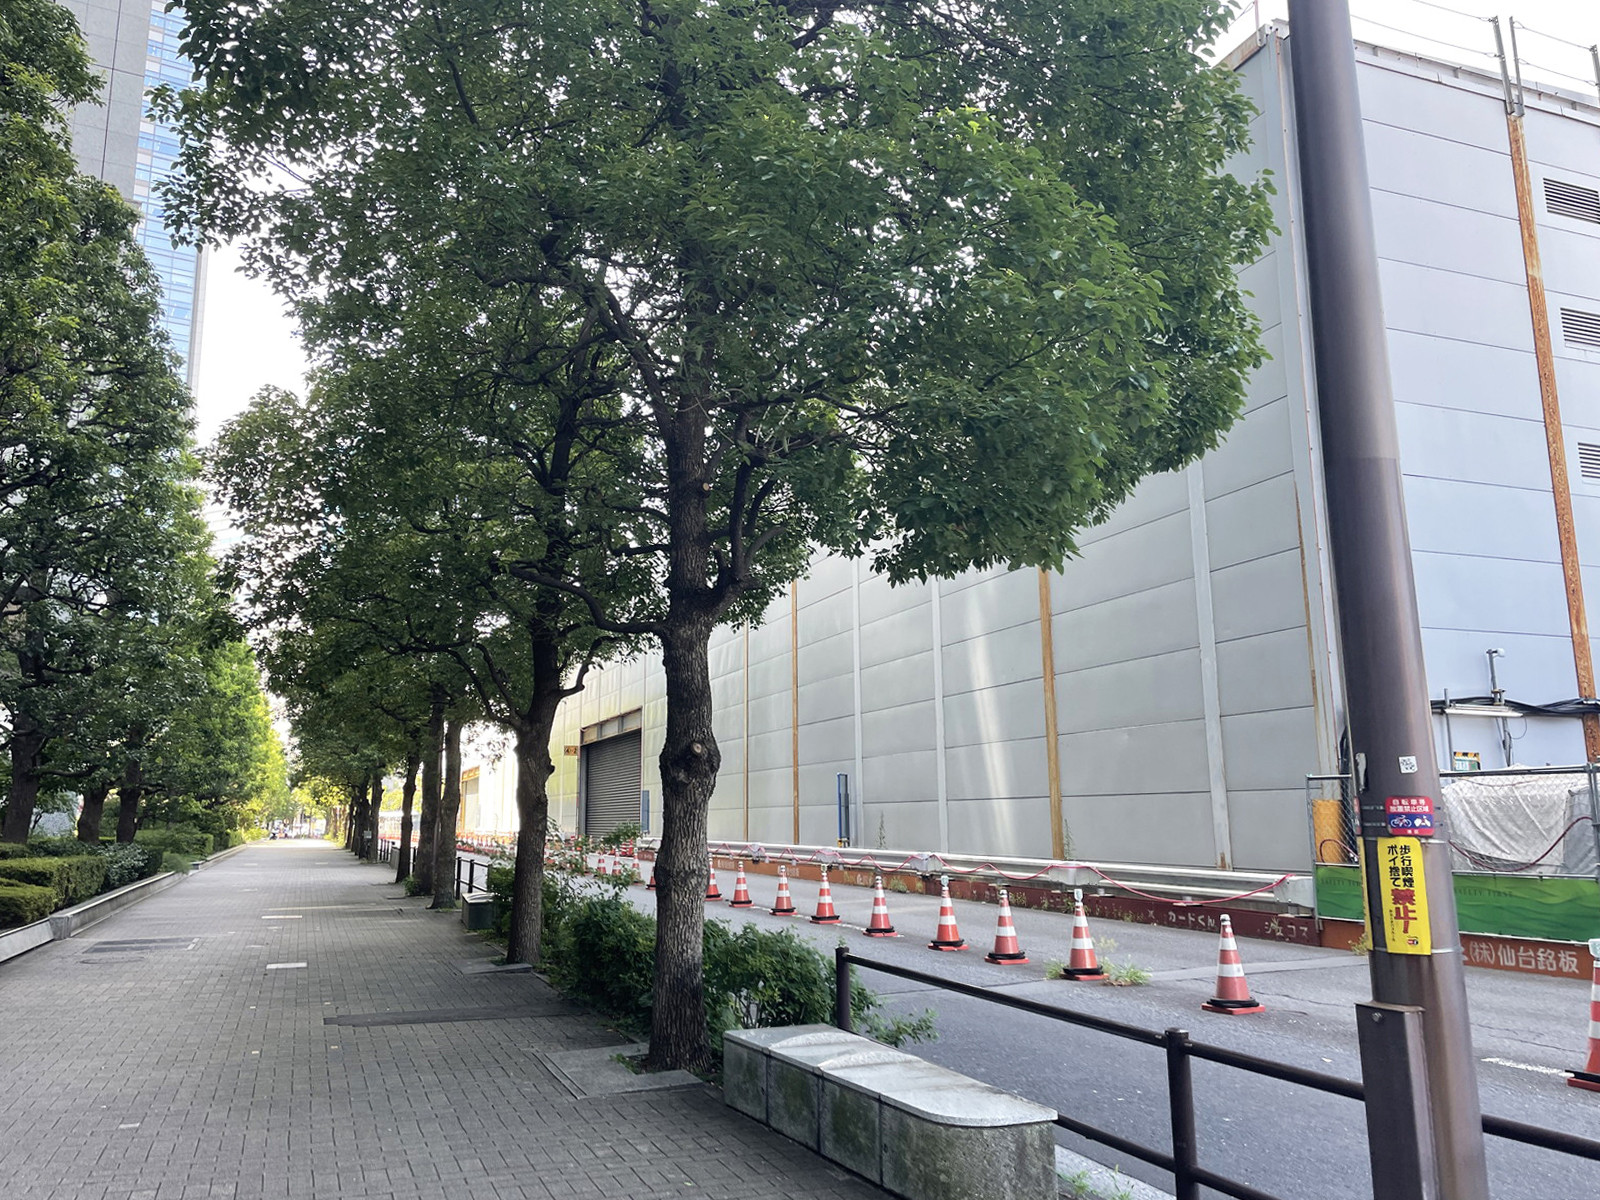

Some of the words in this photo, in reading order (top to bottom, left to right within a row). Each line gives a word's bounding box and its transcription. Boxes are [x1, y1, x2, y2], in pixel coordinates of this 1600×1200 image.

[1389, 805, 1429, 813] 放置禁止区域
[1387, 844, 1402, 888] ポイ捨て
[1399, 844, 1415, 888] 歩行喫煙
